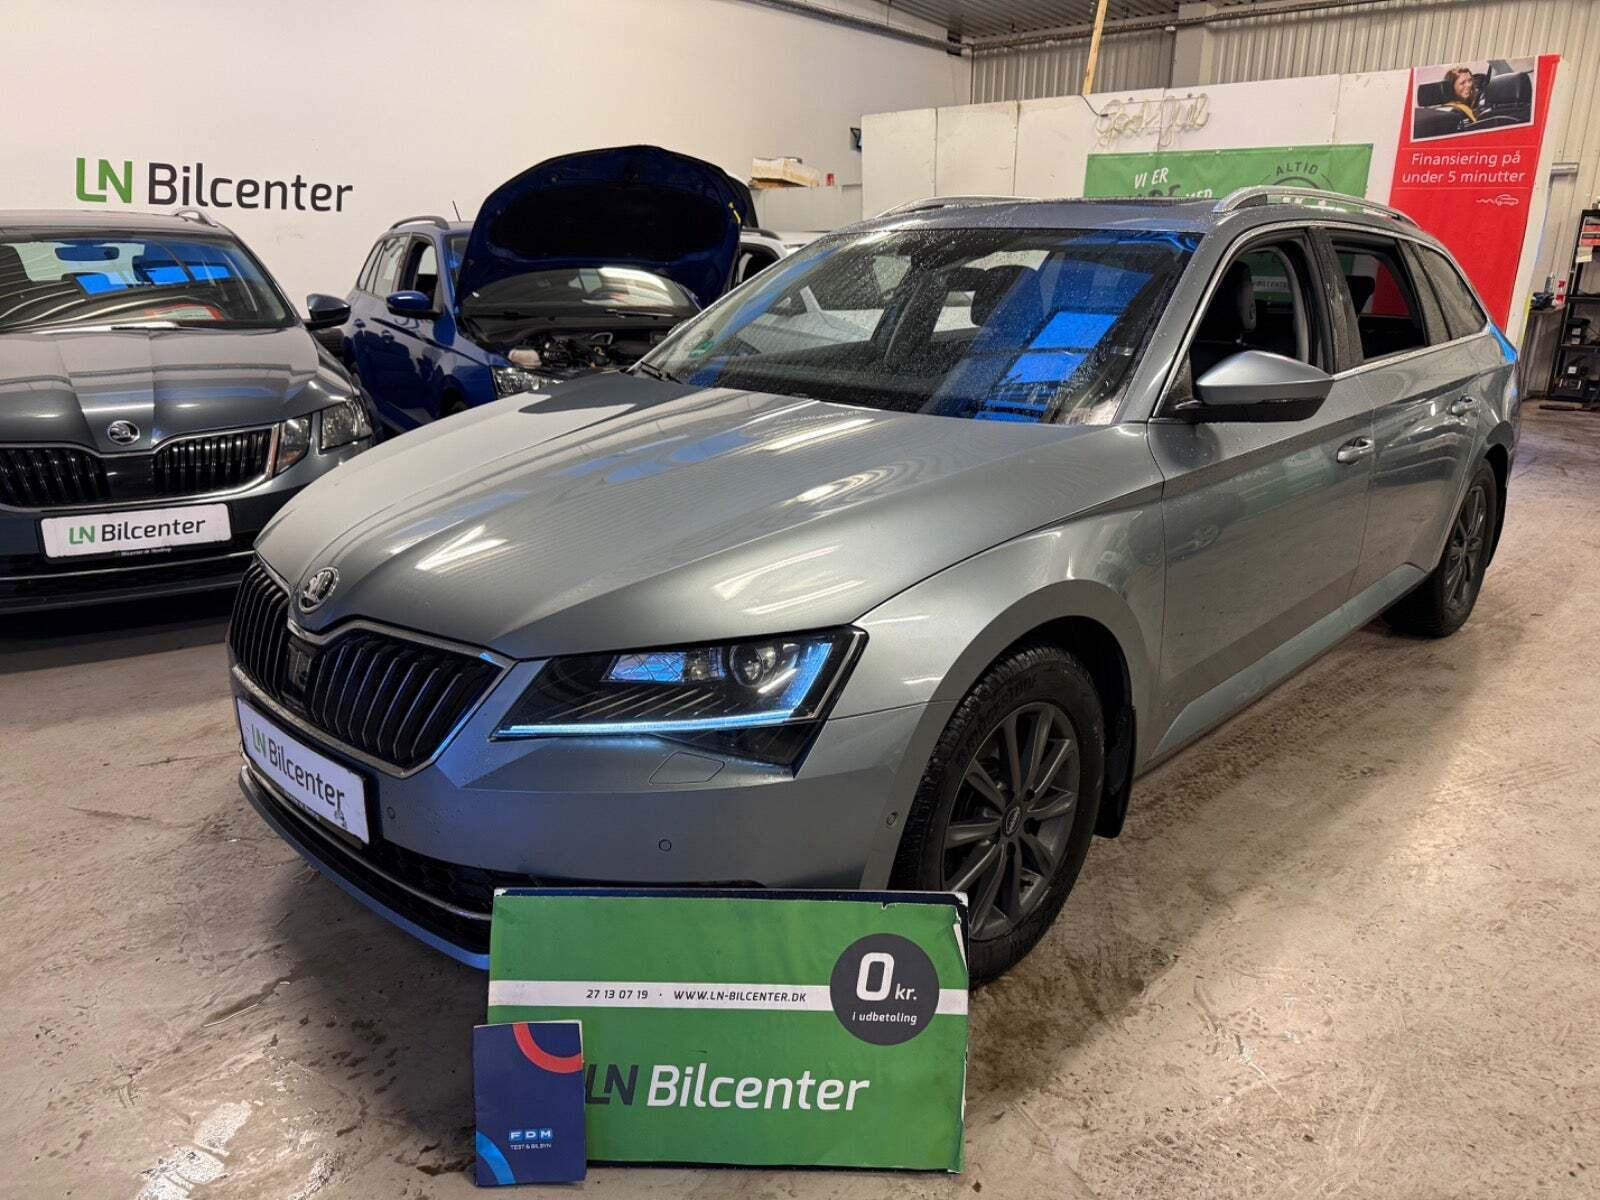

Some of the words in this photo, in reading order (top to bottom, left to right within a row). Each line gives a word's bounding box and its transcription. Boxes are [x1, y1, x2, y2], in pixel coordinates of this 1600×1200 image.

[1275, 161, 1319, 175] ALTID
[1411, 151, 1497, 168] Finansiering
[1501, 150, 1521, 167] på
[76, 157, 133, 204] LN
[148, 162, 353, 212] Bilcenter
[1134, 171, 1148, 190] VI
[1151, 167, 1169, 185] ER
[1402, 170, 1443, 183] under
[1447, 170, 1457, 183] 5
[1460, 169, 1526, 183] minutter
[69, 525, 95, 545] LN
[101, 519, 206, 542] Bilcenter
[268, 737, 345, 813] Bilcenter
[856, 952, 895, 1001] 0
[894, 983, 918, 1001] kr.
[585, 988, 600, 999] 27
[604, 989, 615, 999] 13
[618, 989, 633, 999] 07
[637, 989, 649, 999] 19
[673, 990, 807, 1003] WWW.LN-BILCENTER.DK
[858, 1012, 918, 1026] udbetaling
[585, 1064, 639, 1106] LN
[646, 1062, 870, 1111] Bilcenter
[510, 1130, 552, 1140] FDM
